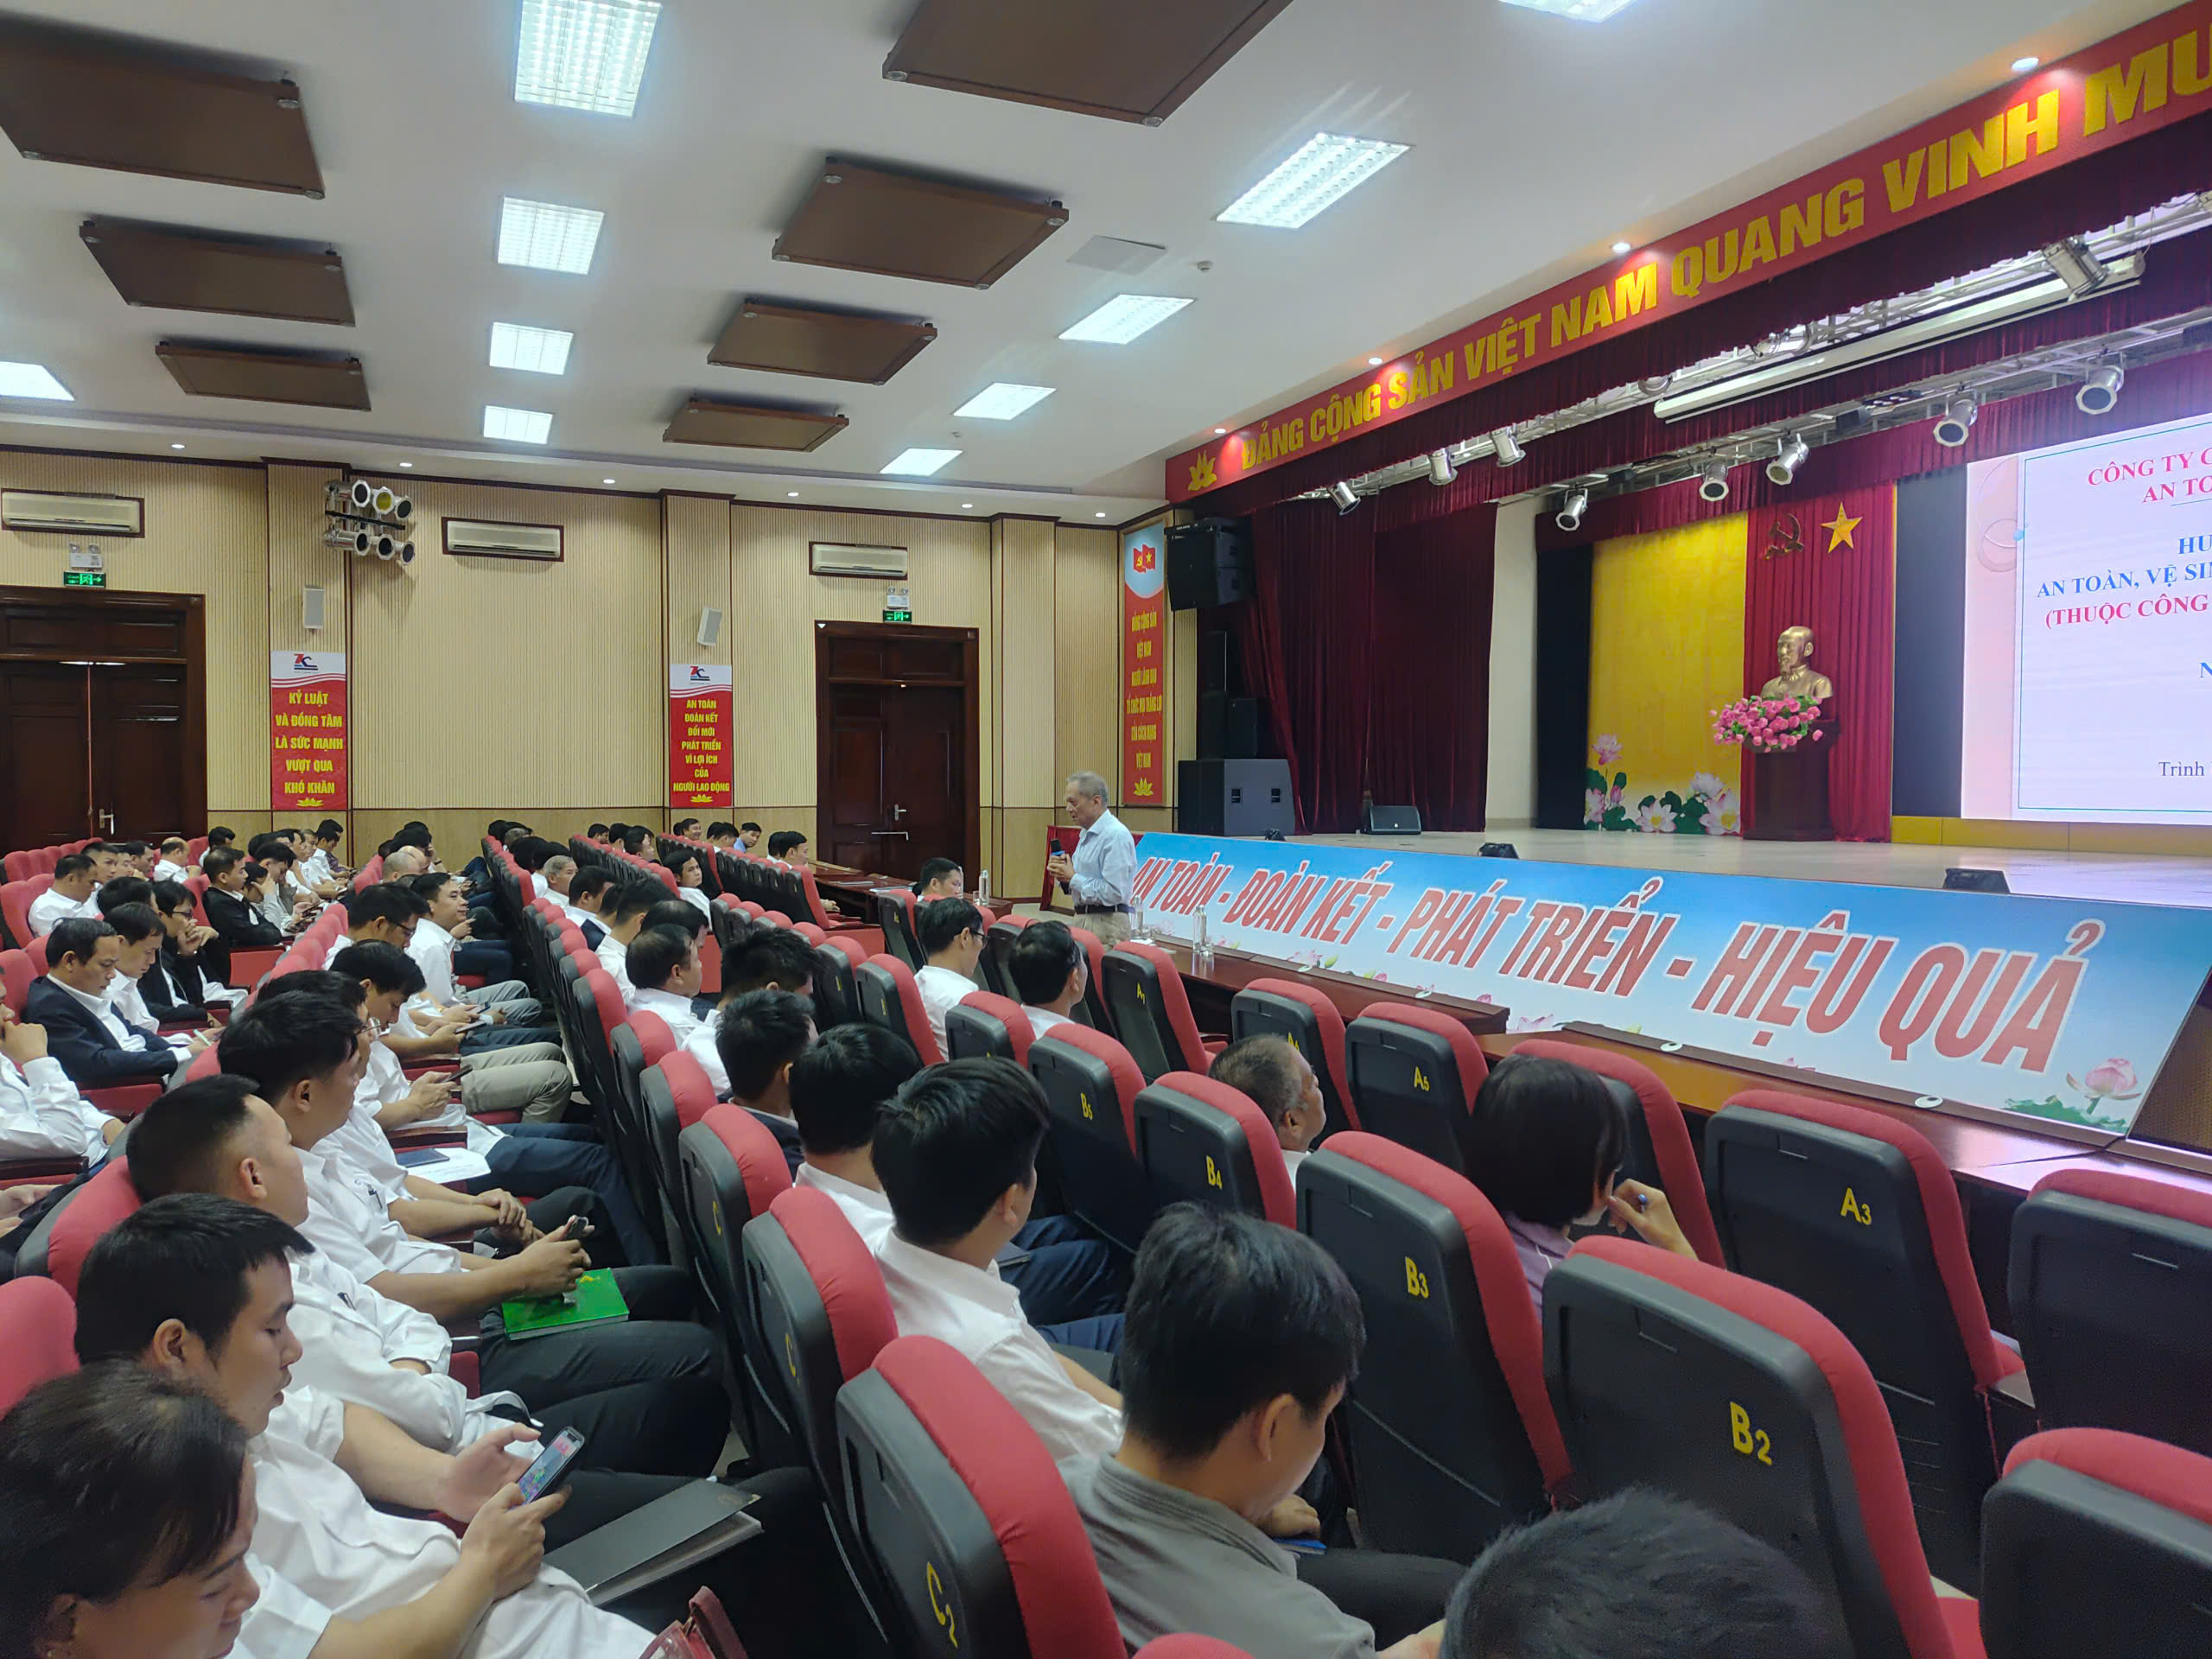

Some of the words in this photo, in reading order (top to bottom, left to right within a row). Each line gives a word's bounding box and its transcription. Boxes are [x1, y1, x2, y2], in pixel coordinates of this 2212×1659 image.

[1242, 421, 1304, 470] ĐẢNG
[1310, 383, 1381, 442] CỘNG
[1388, 350, 1453, 410] SẢN
[1465, 313, 1541, 380] VIỆT
[1551, 262, 1657, 347] NAM
[1672, 177, 1865, 297] QUANG
[1882, 89, 2059, 213] VINH
[2088, 461, 2154, 486] CÔNG
[2162, 451, 2194, 473] TY
[2143, 482, 2176, 503] AN
[2037, 580, 2065, 598] AN
[2072, 569, 2139, 594] TOÀN,
[2145, 564, 2177, 588] VỆ
[2045, 602, 2132, 630] (THUỘC
[2138, 593, 2209, 617] CÔNG
[289, 690, 302, 705] KỶ
[304, 691, 329, 707] LUẬT
[686, 699, 696, 709] AN
[275, 712, 289, 727] VÀ
[321, 713, 343, 728] TÂM
[705, 712, 718, 723] KẾT
[290, 735, 311, 749] SỨC
[313, 738, 344, 752] MẠNH
[681, 740, 700, 750] PHÁT
[286, 760, 311, 773] VƯỢT
[314, 760, 334, 772] QUA
[694, 766, 709, 779] CỦA
[2158, 761, 2205, 777] Trình
[284, 780, 305, 794] KHÓ
[308, 781, 335, 794] KHĂN
[696, 783, 709, 791] LAO
[710, 782, 730, 793] ĐỘNG
[1130, 857, 1173, 905] AN
[1300, 861, 1395, 945] KẾT
[1386, 879, 1522, 969] PHÁT
[1498, 876, 1681, 998] TRIỂN
[1691, 910, 1899, 1047] HIỆU
[1877, 918, 2106, 1074] QUẢ
[1414, 1065, 1430, 1091] A5
[1080, 1092, 1094, 1121] B5
[1205, 1154, 1223, 1190] B4
[1840, 1187, 1872, 1225] A3
[1404, 1256, 1429, 1299] B3
[1729, 1401, 1772, 1466] B2
